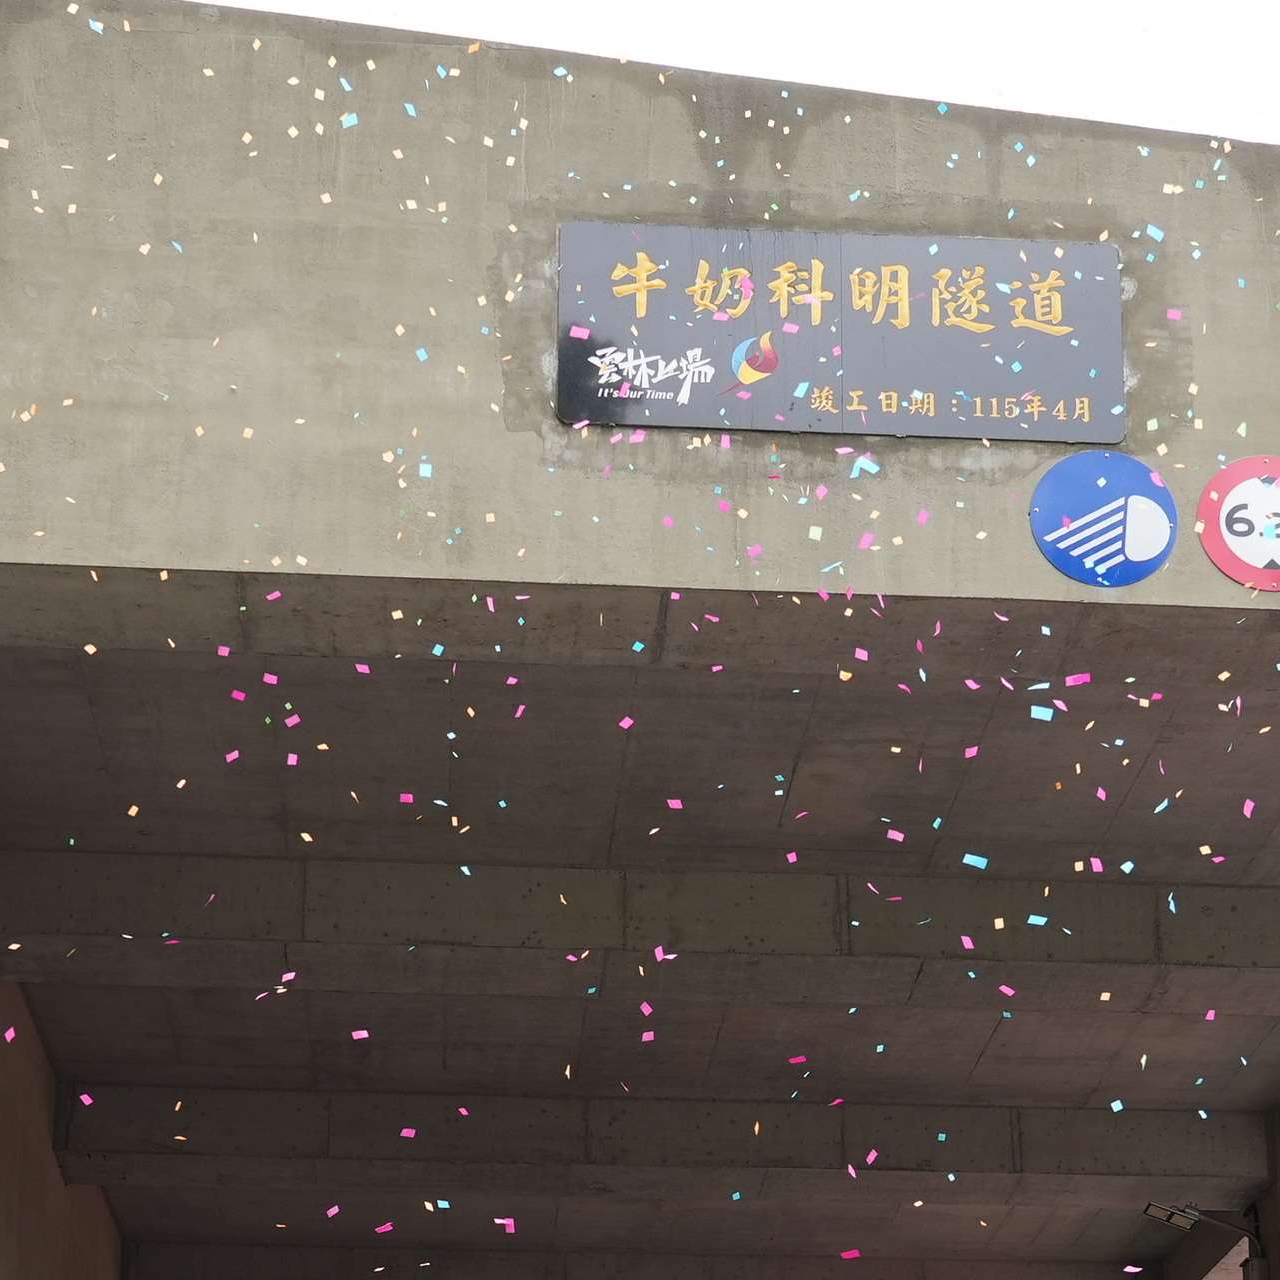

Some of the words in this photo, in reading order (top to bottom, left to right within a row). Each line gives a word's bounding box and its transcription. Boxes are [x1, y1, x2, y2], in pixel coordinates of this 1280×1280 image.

[610, 252, 1074, 335] 牛奶科明隧道
[597, 387, 619, 398] It's
[645, 389, 674, 400] Time
